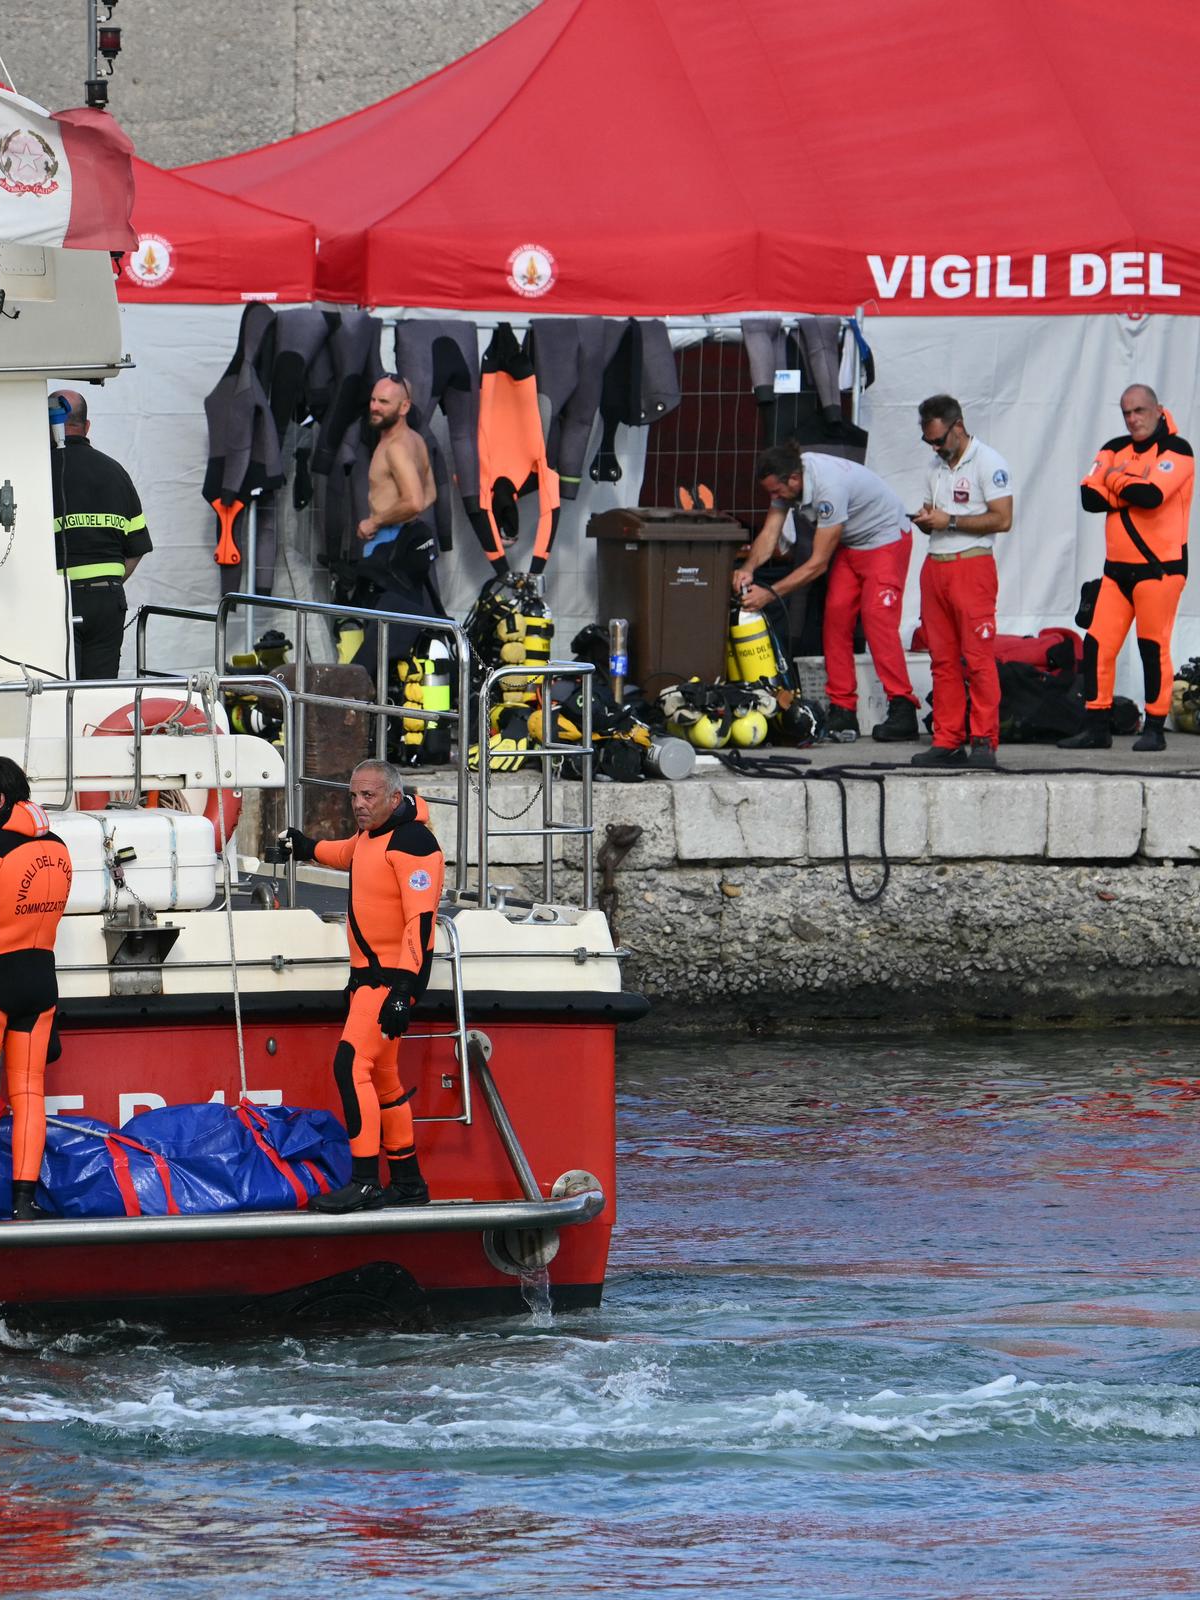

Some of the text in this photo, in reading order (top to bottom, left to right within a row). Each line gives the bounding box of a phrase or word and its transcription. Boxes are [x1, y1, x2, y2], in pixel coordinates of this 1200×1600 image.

[866, 251, 1181, 299] VIGILI DEL
[85, 514, 102, 526] DEL
[17, 863, 38, 903] VIGILI
[35, 855, 55, 870] DEL
